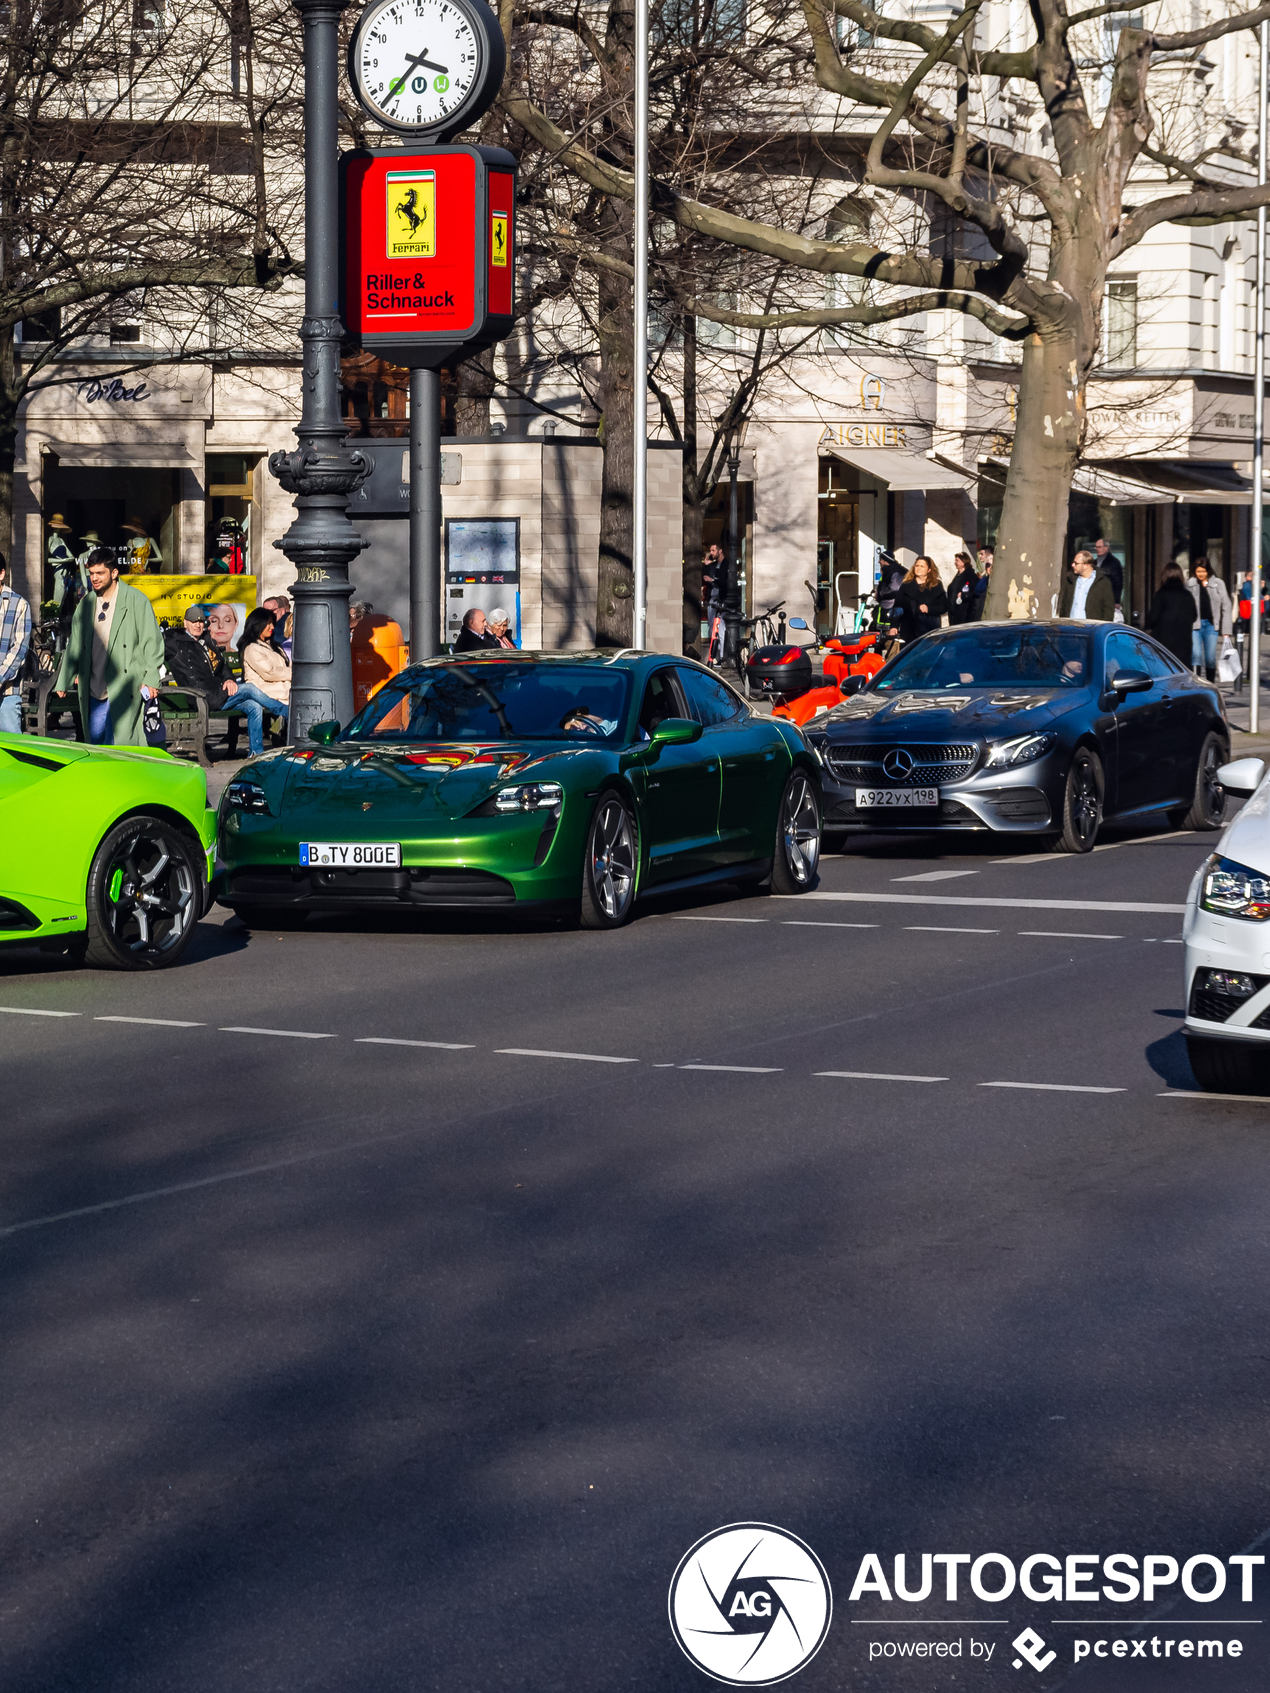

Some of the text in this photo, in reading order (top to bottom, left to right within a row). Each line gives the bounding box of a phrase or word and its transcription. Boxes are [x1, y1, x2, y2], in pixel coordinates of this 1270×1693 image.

[415, 7, 424, 17] 12
[394, 14, 403, 25] 11
[439, 13, 444, 22] 1
[377, 34, 387, 44] 10
[455, 29, 461, 39] 2
[372, 58, 378, 67] 9
[460, 53, 466, 63] 3
[378, 82, 384, 91] 8
[454, 78, 460, 88] 4
[394, 100, 400, 109] 7
[439, 97, 444, 107] 5
[416, 105, 422, 114] 6
[392, 242, 430, 254] Ferrari
[366, 273, 411, 291] Riller
[366, 290, 455, 309] Schnauck
[818, 425, 907, 447] AIGNER
[914, 789, 935, 801] 198
[309, 846, 397, 864] B TY 800E
